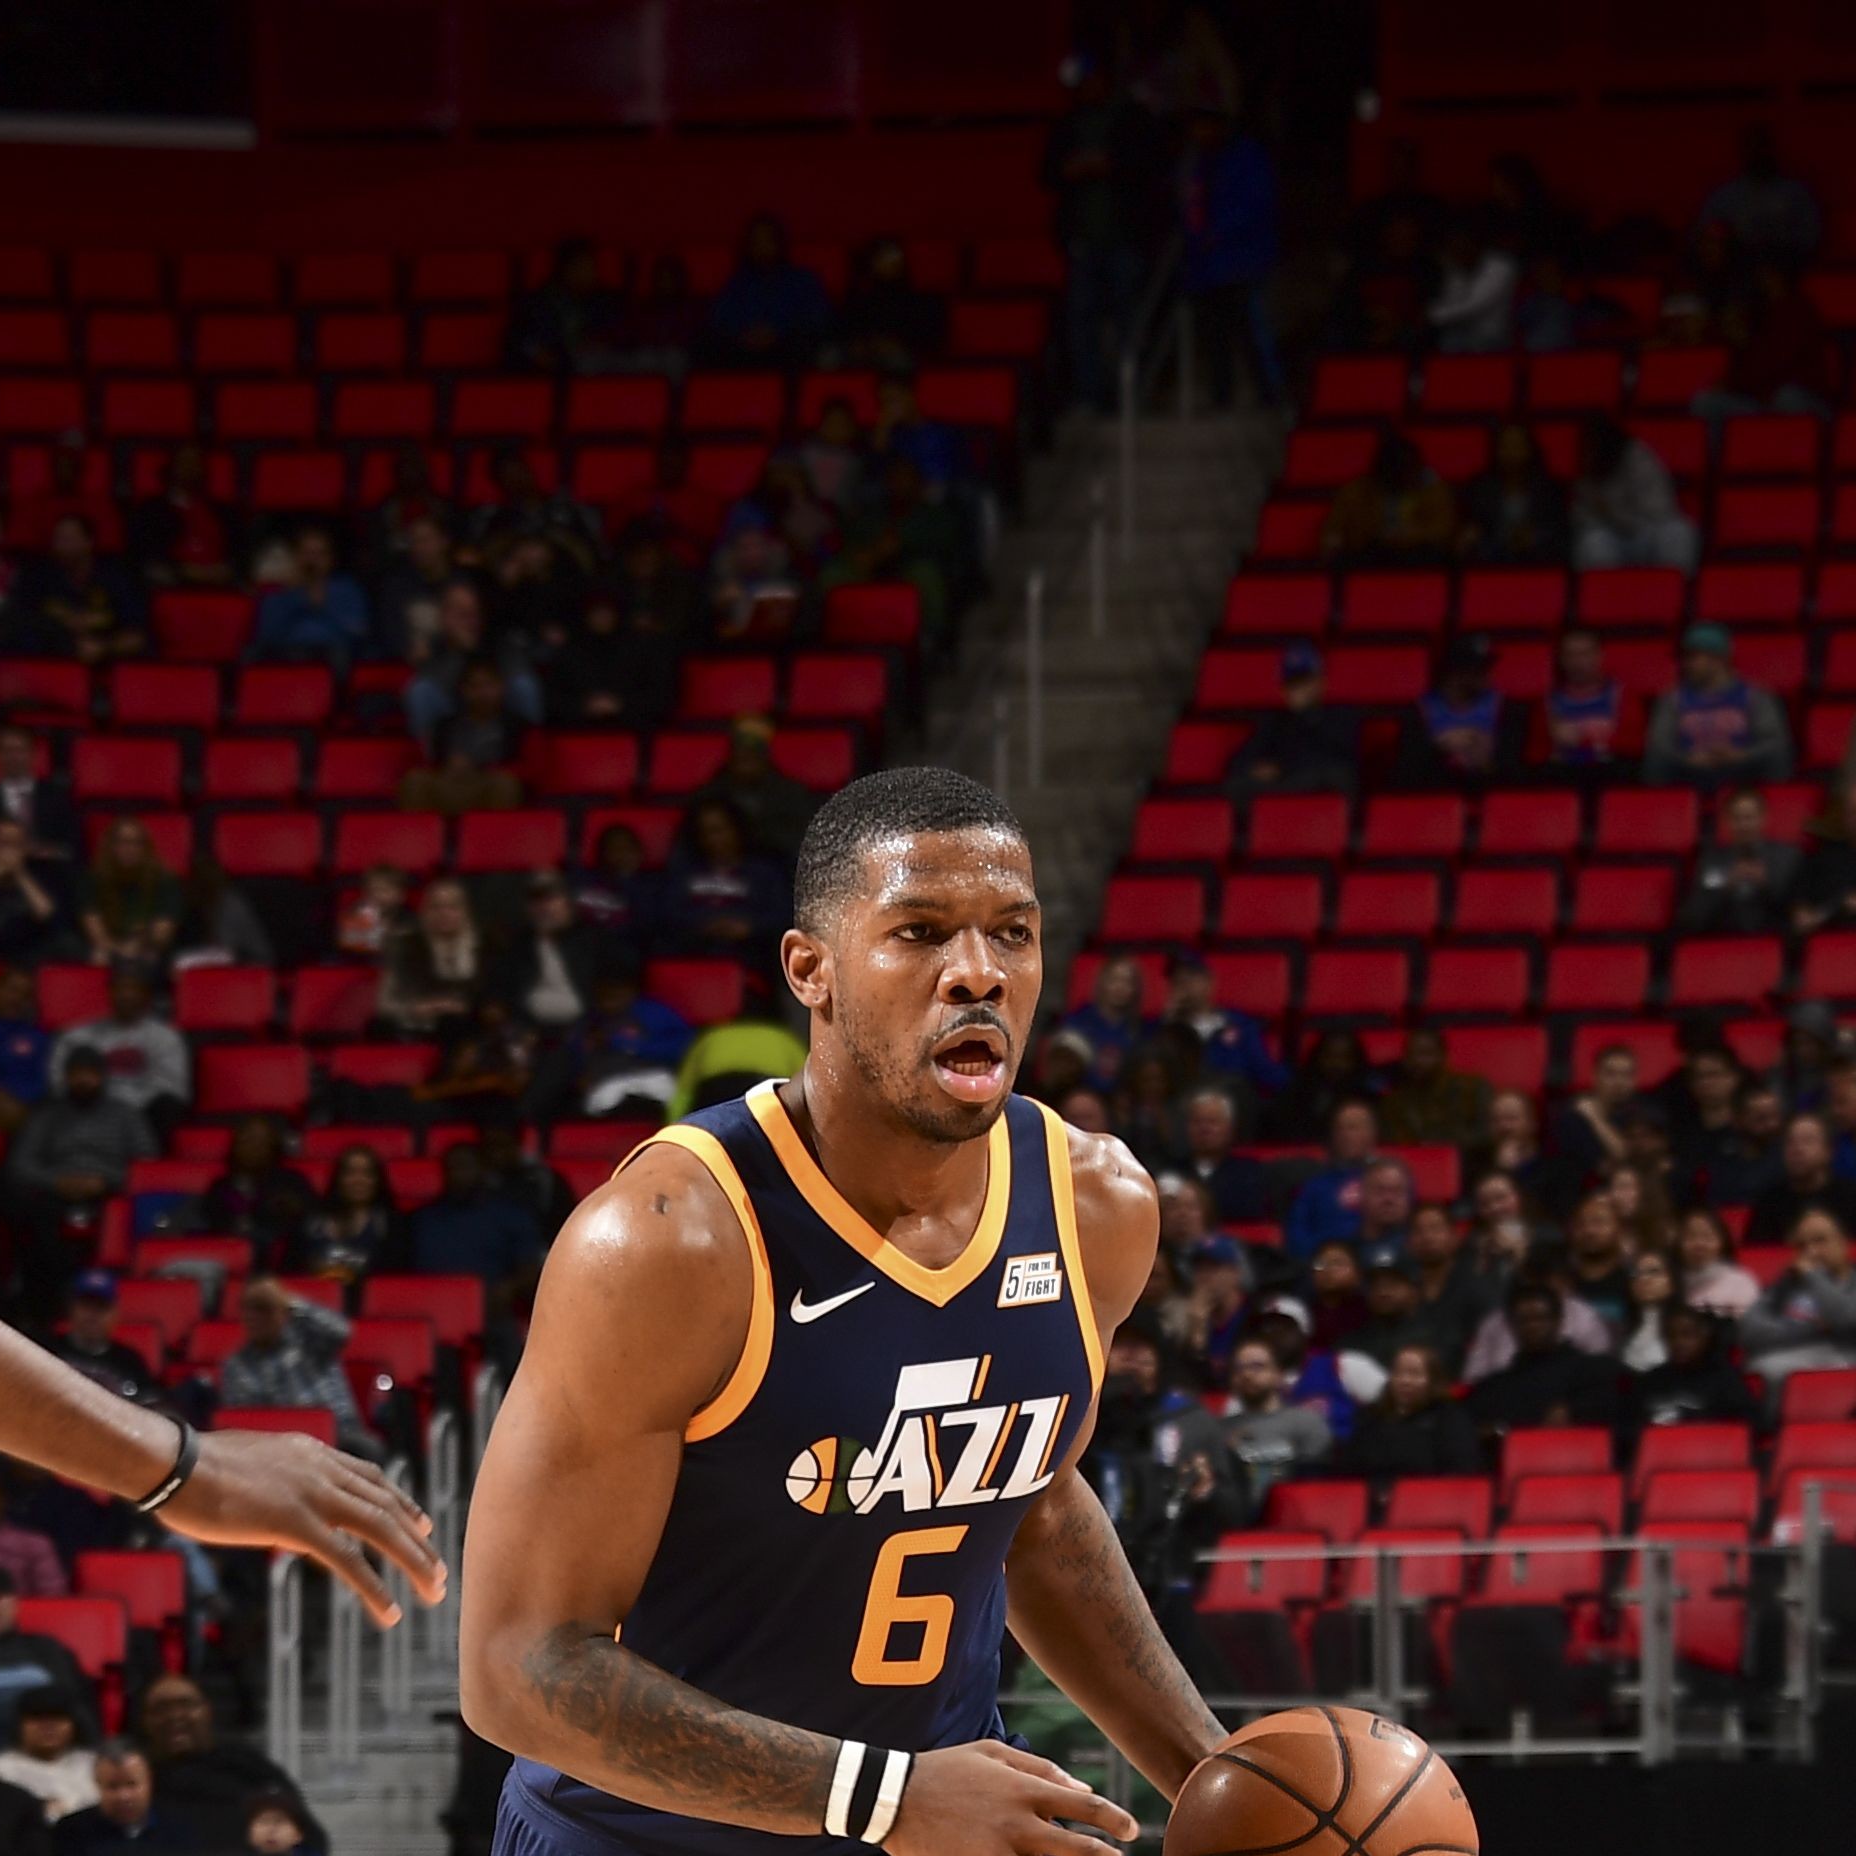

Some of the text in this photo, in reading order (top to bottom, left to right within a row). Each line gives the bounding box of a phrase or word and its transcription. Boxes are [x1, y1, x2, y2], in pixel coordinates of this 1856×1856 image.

[1005, 1264, 1021, 1299] 5
[1028, 1260, 1051, 1273] FOR THE
[1024, 1278, 1056, 1297] FIGHT
[785, 1354, 1070, 1515] JAZZ
[851, 1524, 971, 1686] 6
